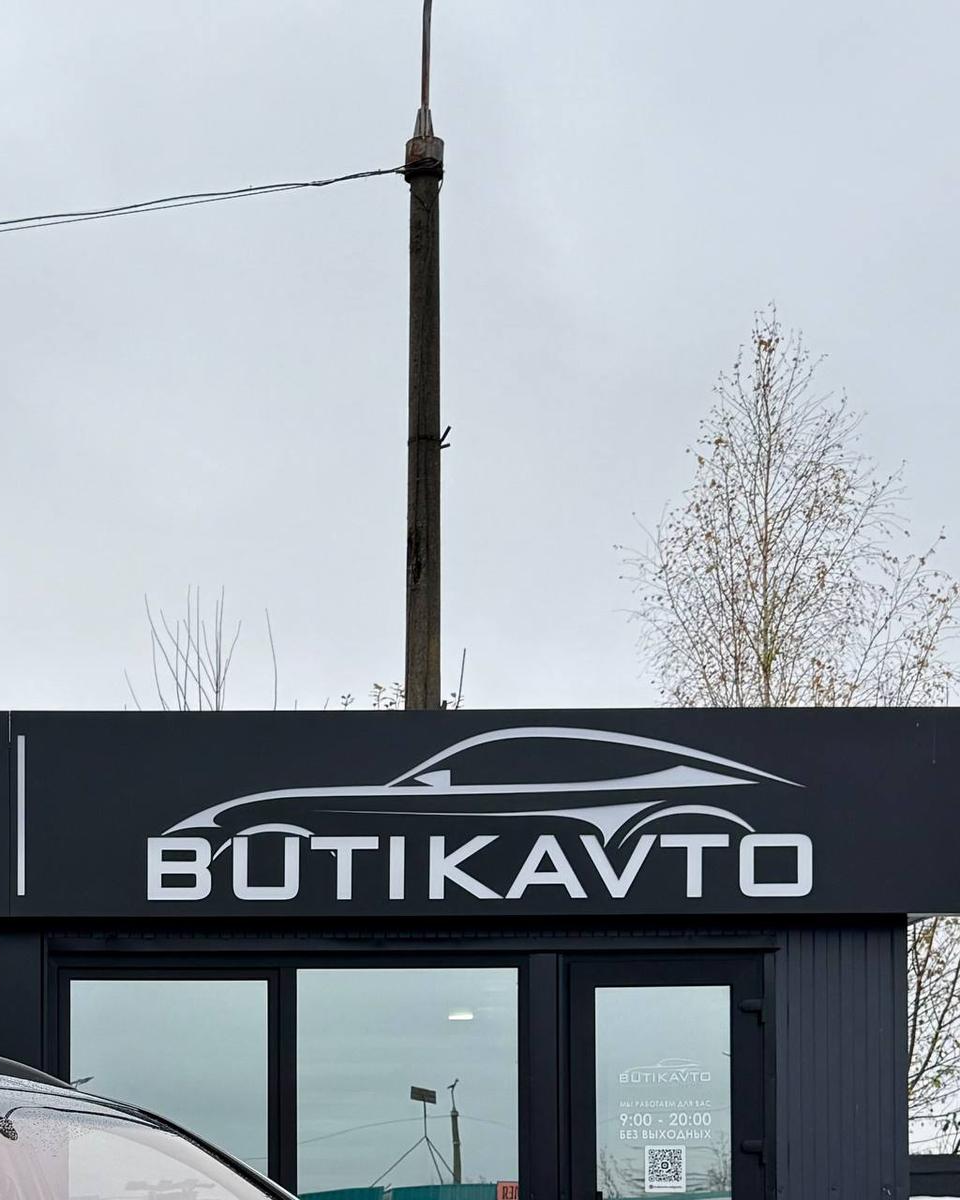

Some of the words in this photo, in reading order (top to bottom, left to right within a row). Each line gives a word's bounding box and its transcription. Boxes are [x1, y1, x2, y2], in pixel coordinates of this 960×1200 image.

[146, 832, 814, 902] BUTIKAVTO
[619, 1072, 711, 1083] BUTIKAVTO
[619, 1113, 652, 1126] 9:00
[669, 1112, 712, 1126] 20:00
[619, 1129, 638, 1139] БЕЗ
[642, 1129, 711, 1140] ВЫХОДНЫХ
